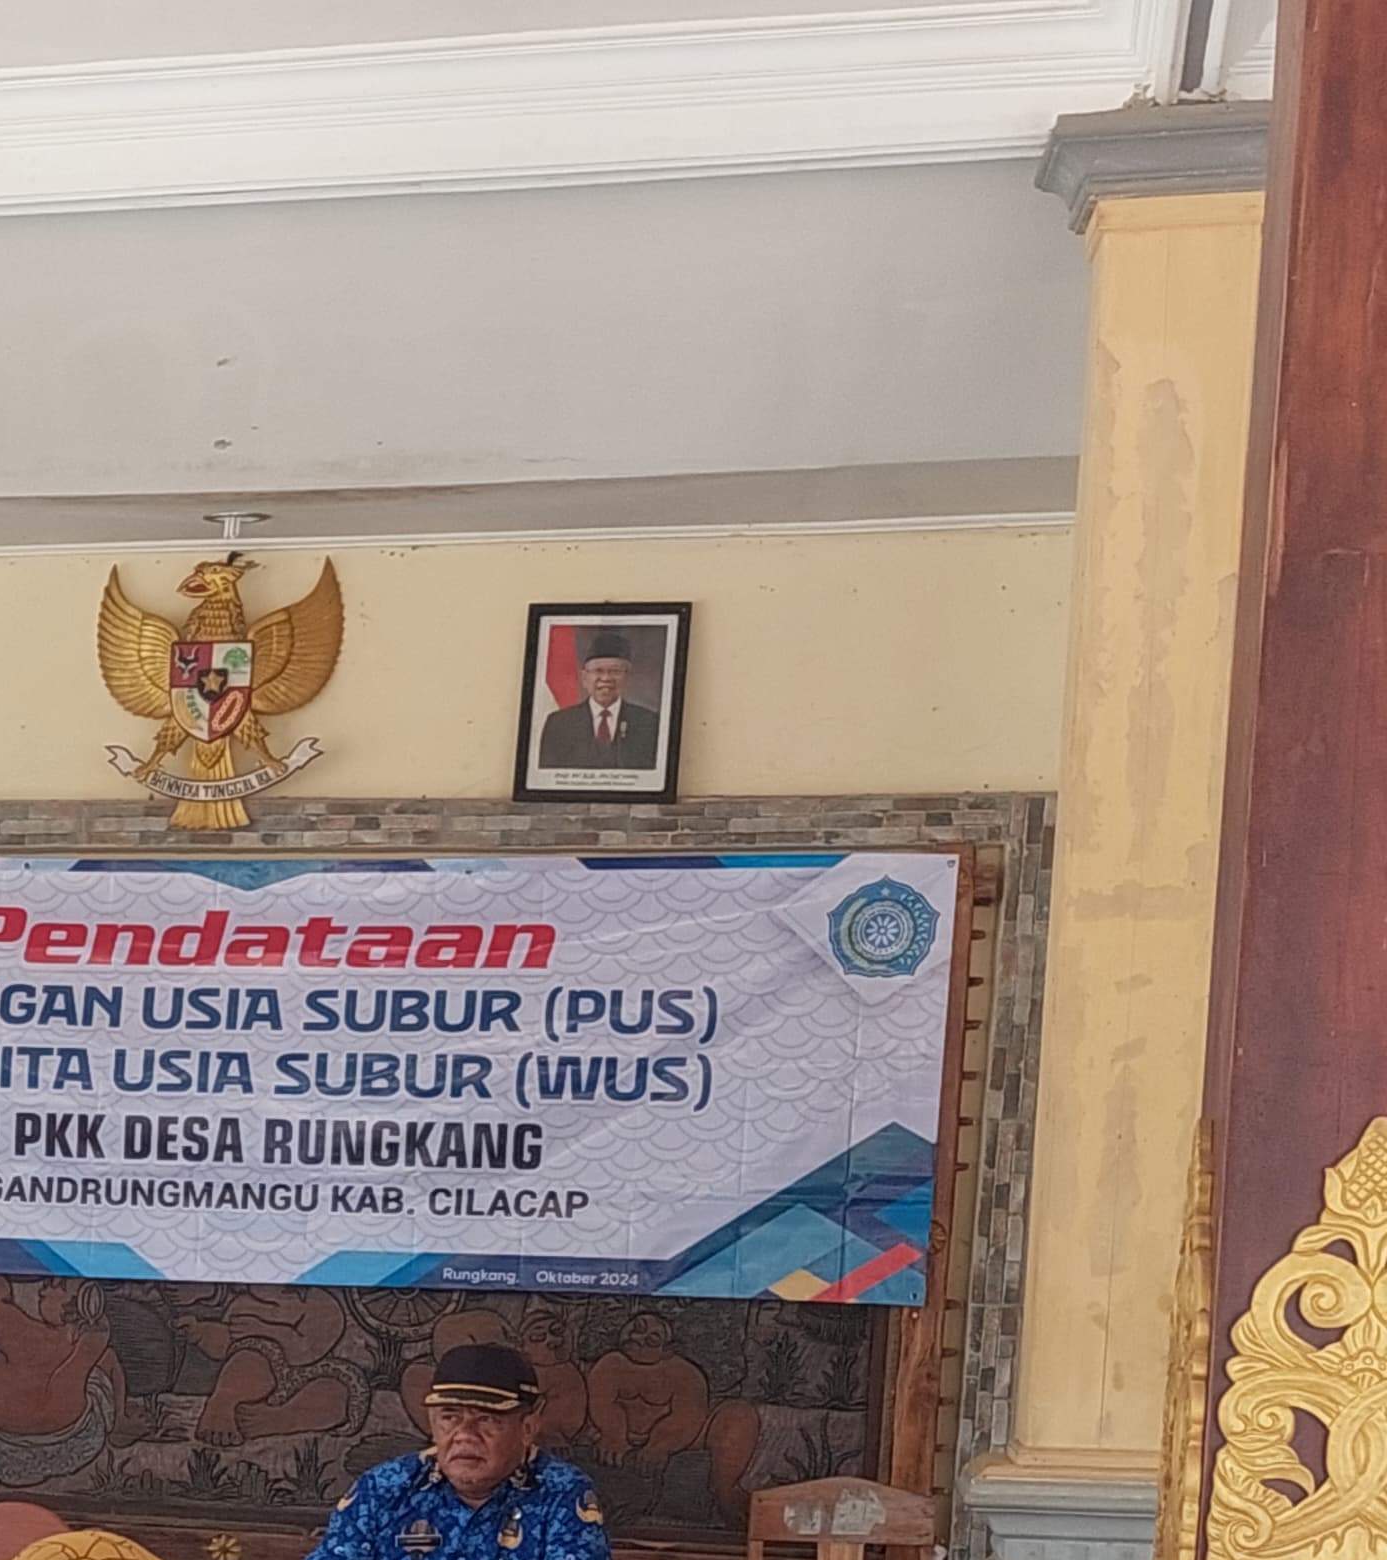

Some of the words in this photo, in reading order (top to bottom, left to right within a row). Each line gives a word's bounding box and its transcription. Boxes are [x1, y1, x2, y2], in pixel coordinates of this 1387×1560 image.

[141, 986, 284, 1031] USIA
[302, 989, 523, 1033] SUBUR
[544, 986, 718, 1044] (PUS)
[113, 1048, 255, 1095] USIA
[273, 1052, 493, 1099] SUBUR
[515, 1052, 713, 1112] (WUS)
[14, 1111, 106, 1159] PKK
[123, 1115, 245, 1163] DESA
[262, 1118, 544, 1170] RUNGKANG
[330, 1185, 416, 1216] KAB.
[428, 1187, 590, 1219] CILACAP
[536, 1270, 596, 1286] Oktober
[600, 1272, 639, 1287] 2024
